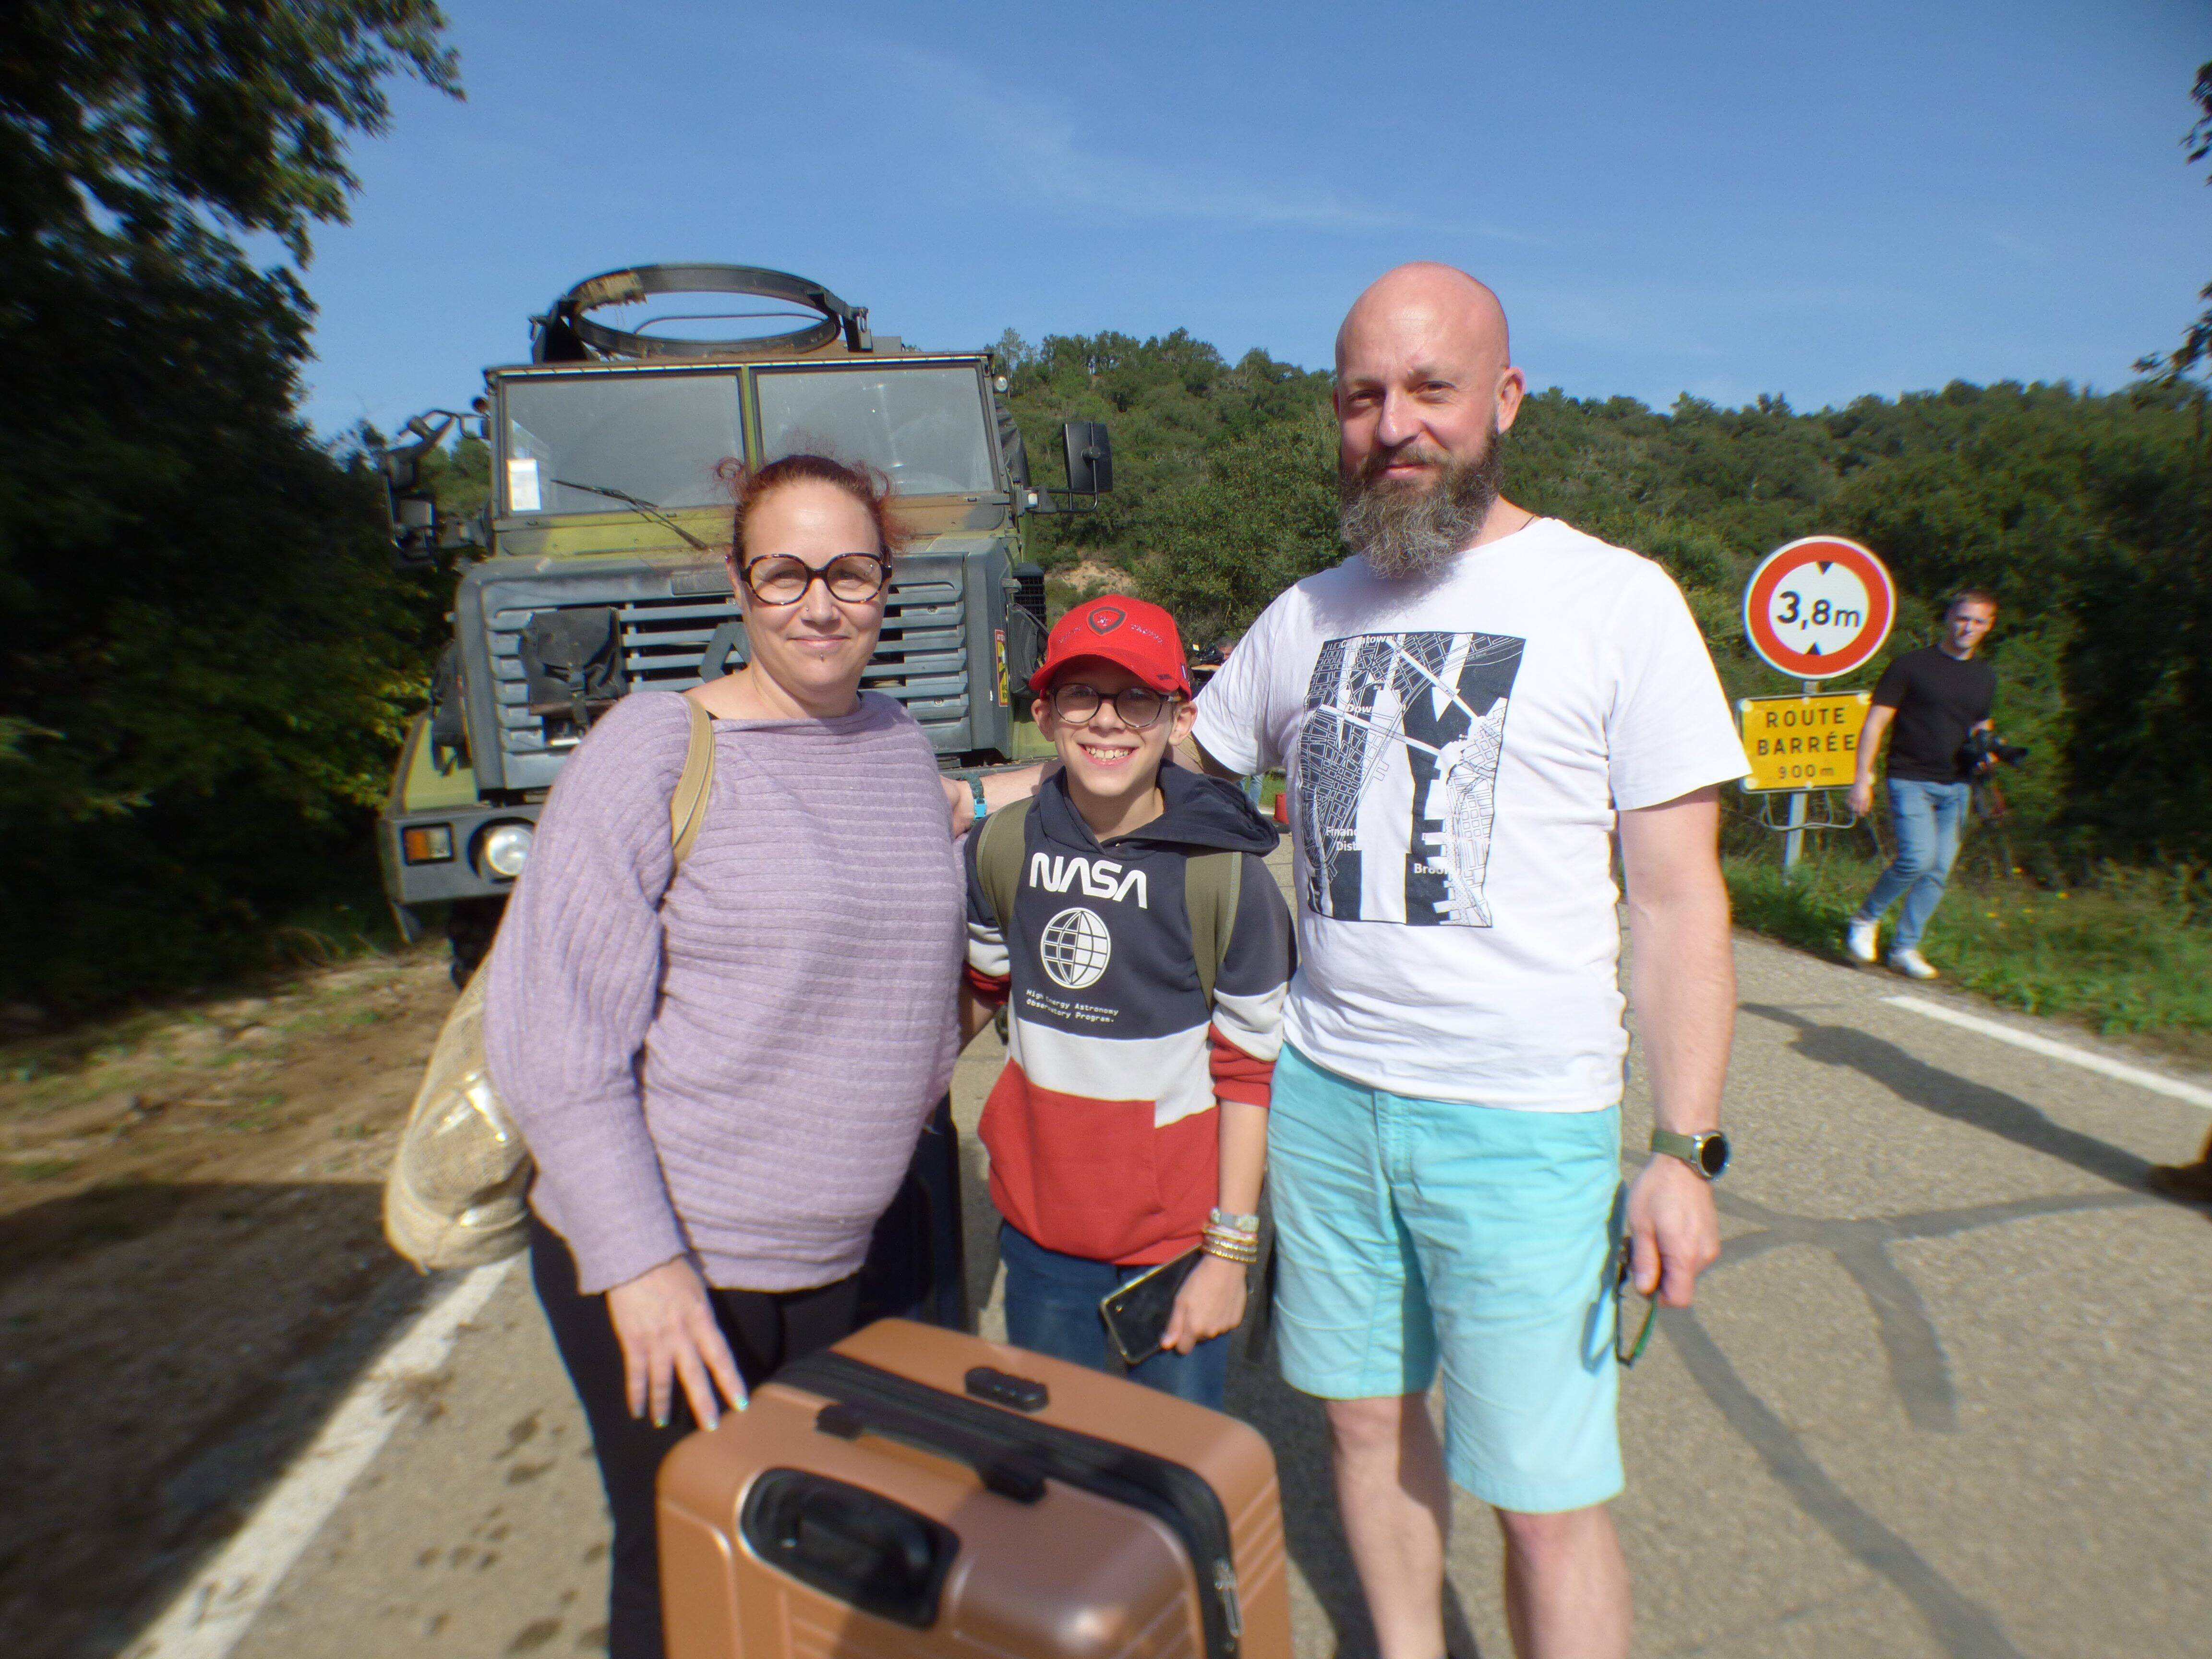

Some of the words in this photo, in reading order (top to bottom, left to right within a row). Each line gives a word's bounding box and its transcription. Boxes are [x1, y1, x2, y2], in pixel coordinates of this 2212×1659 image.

[1766, 707, 1846, 728] ROUTE
[1757, 732, 1856, 756] BARRÉE
[1779, 764, 1815, 779] 900
[1030, 852, 1148, 909] NASA
[1026, 989, 1044, 999] High
[1074, 1003, 1119, 1016] Astronomy
